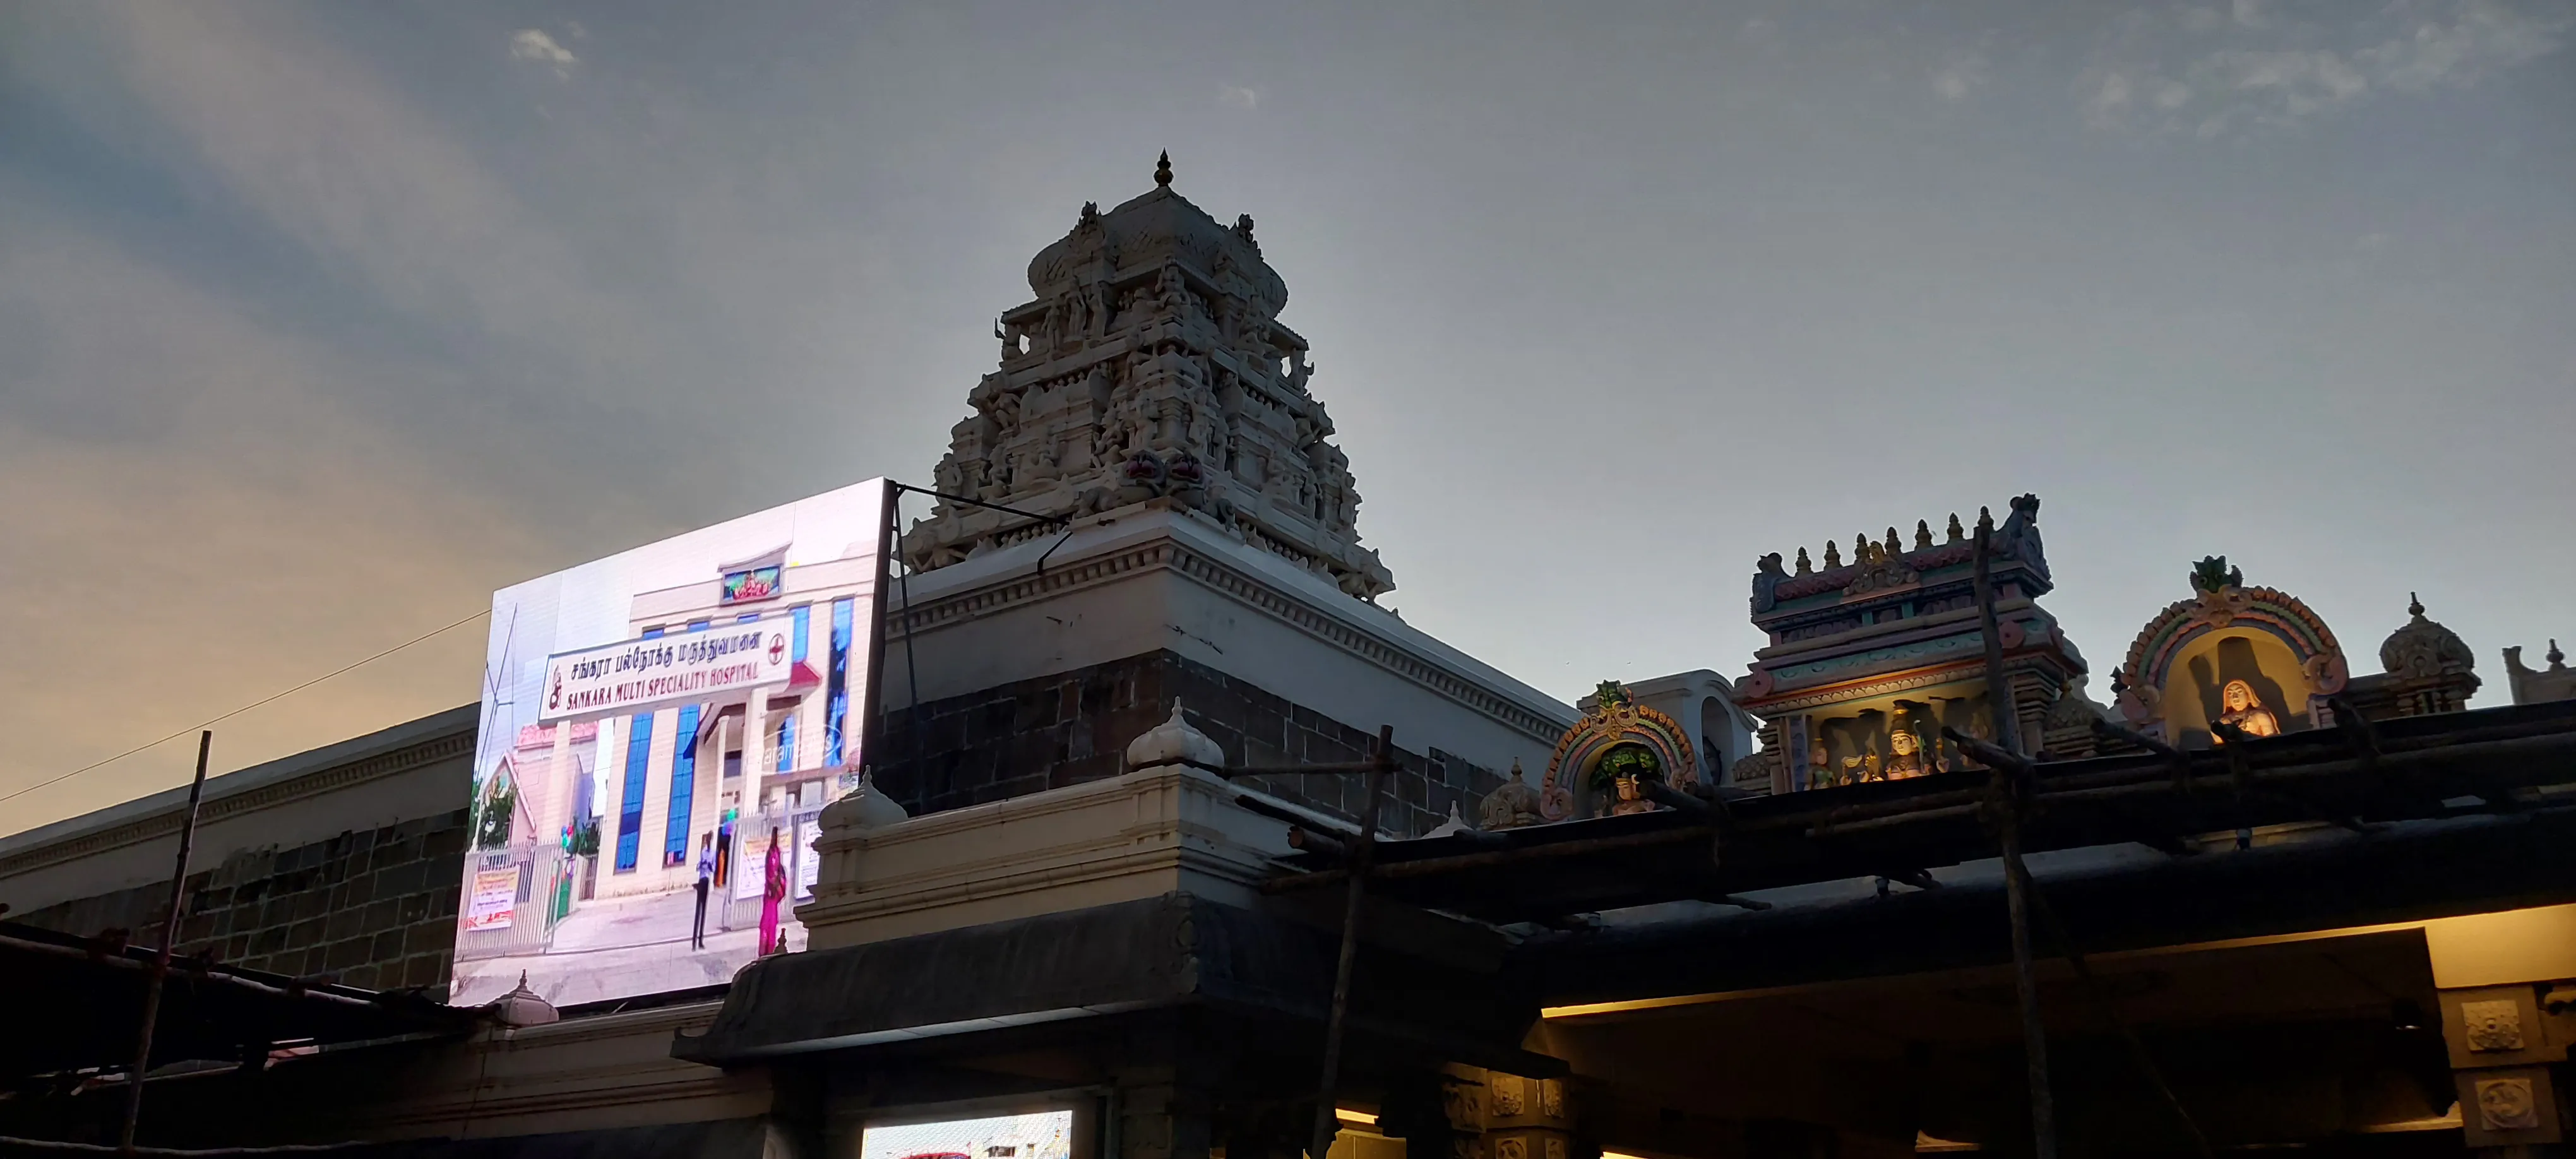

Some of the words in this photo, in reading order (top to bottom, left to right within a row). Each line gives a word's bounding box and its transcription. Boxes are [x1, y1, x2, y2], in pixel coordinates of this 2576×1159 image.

[566, 686, 612, 711] SANKARA
[615, 679, 646, 703] MULTI
[647, 670, 707, 696] SPECIALITY
[710, 662, 759, 686] HOSPITAL
[571, 657, 612, 681] சங்கரா
